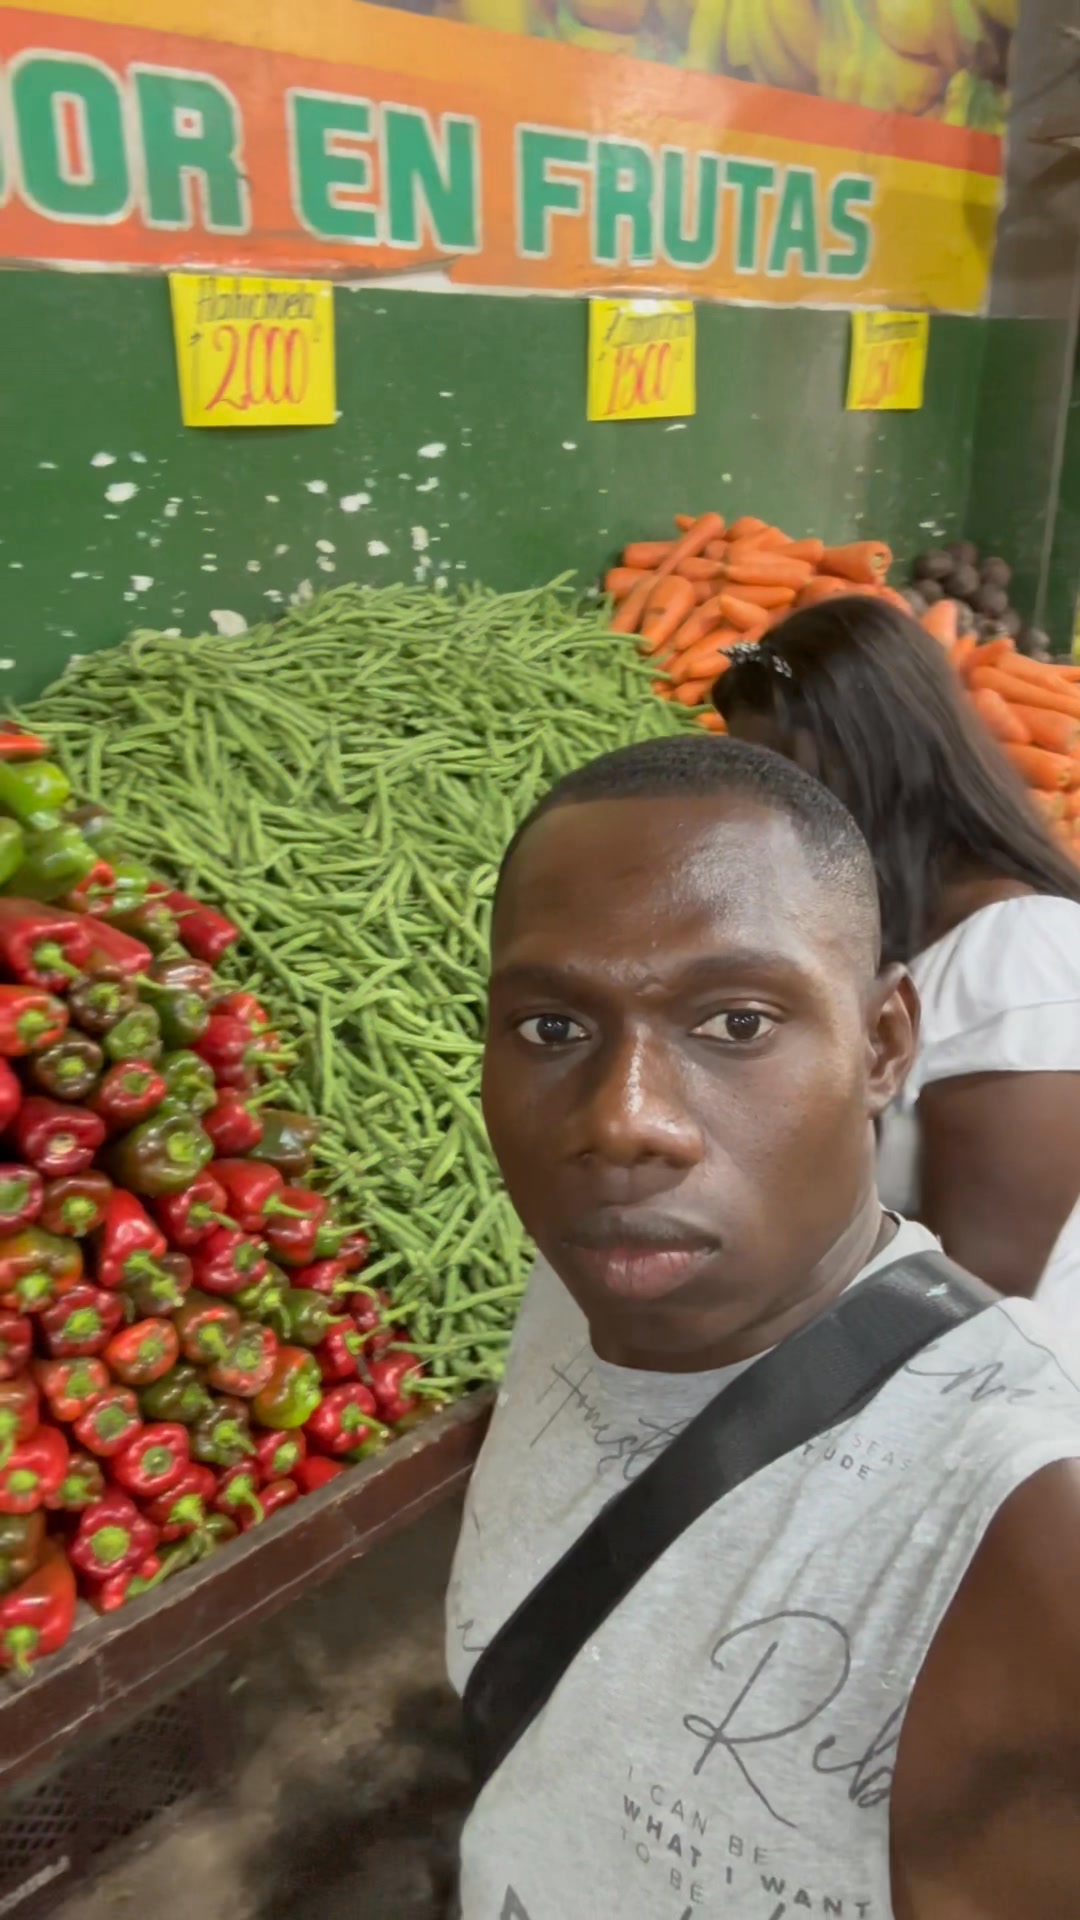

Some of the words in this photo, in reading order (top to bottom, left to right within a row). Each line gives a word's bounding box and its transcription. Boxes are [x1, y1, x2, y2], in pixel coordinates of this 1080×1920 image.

[286, 86, 482, 254] EN
[514, 122, 876, 281] FRUTAS
[204, 322, 310, 412] 2000
[620, 1825, 651, 1864] TO
[669, 1867, 704, 1905] BE
[623, 1794, 702, 1869] WHAT
[725, 1866, 733, 1885] I
[760, 1873, 871, 1919] WANT
[650, 1784, 708, 1836] CAN
[728, 1834, 769, 1866] BE
